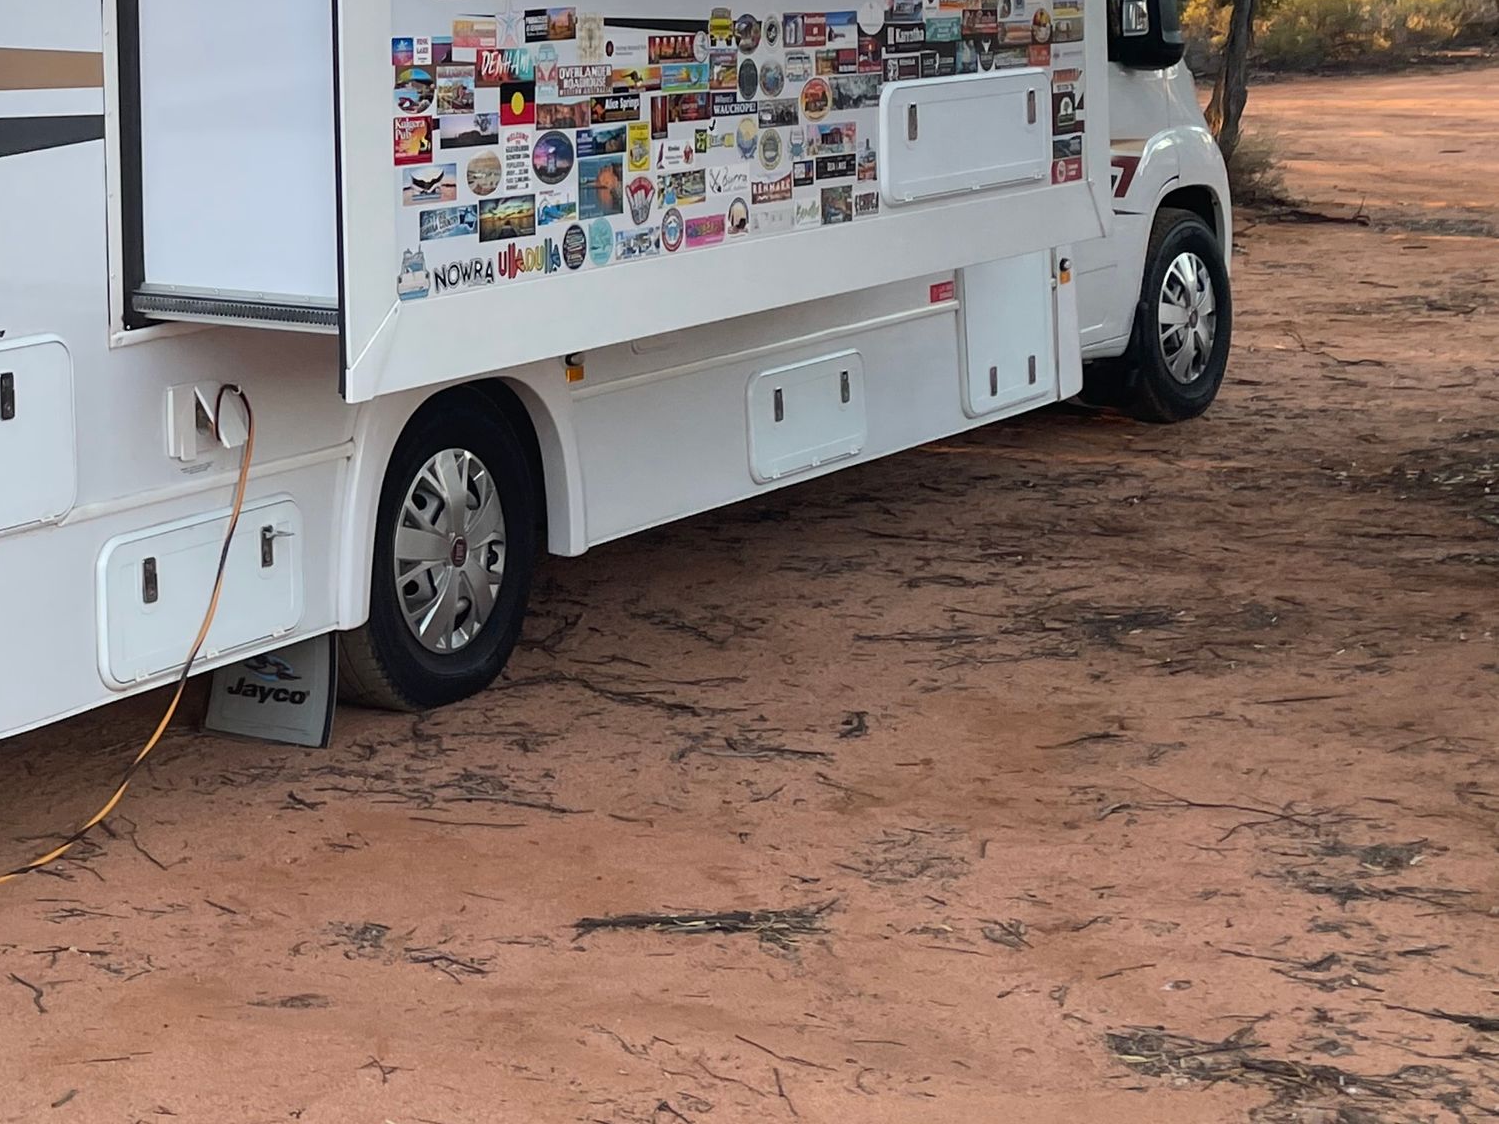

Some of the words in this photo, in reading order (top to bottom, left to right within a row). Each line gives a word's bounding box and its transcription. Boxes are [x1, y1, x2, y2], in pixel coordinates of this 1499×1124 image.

[480, 50, 532, 77] DENHAM
[559, 65, 612, 80] OVERLANDER
[605, 97, 619, 110] Alice
[620, 96, 640, 112] Springs
[434, 260, 495, 293] NOWRA
[227, 677, 307, 704] Jayco
